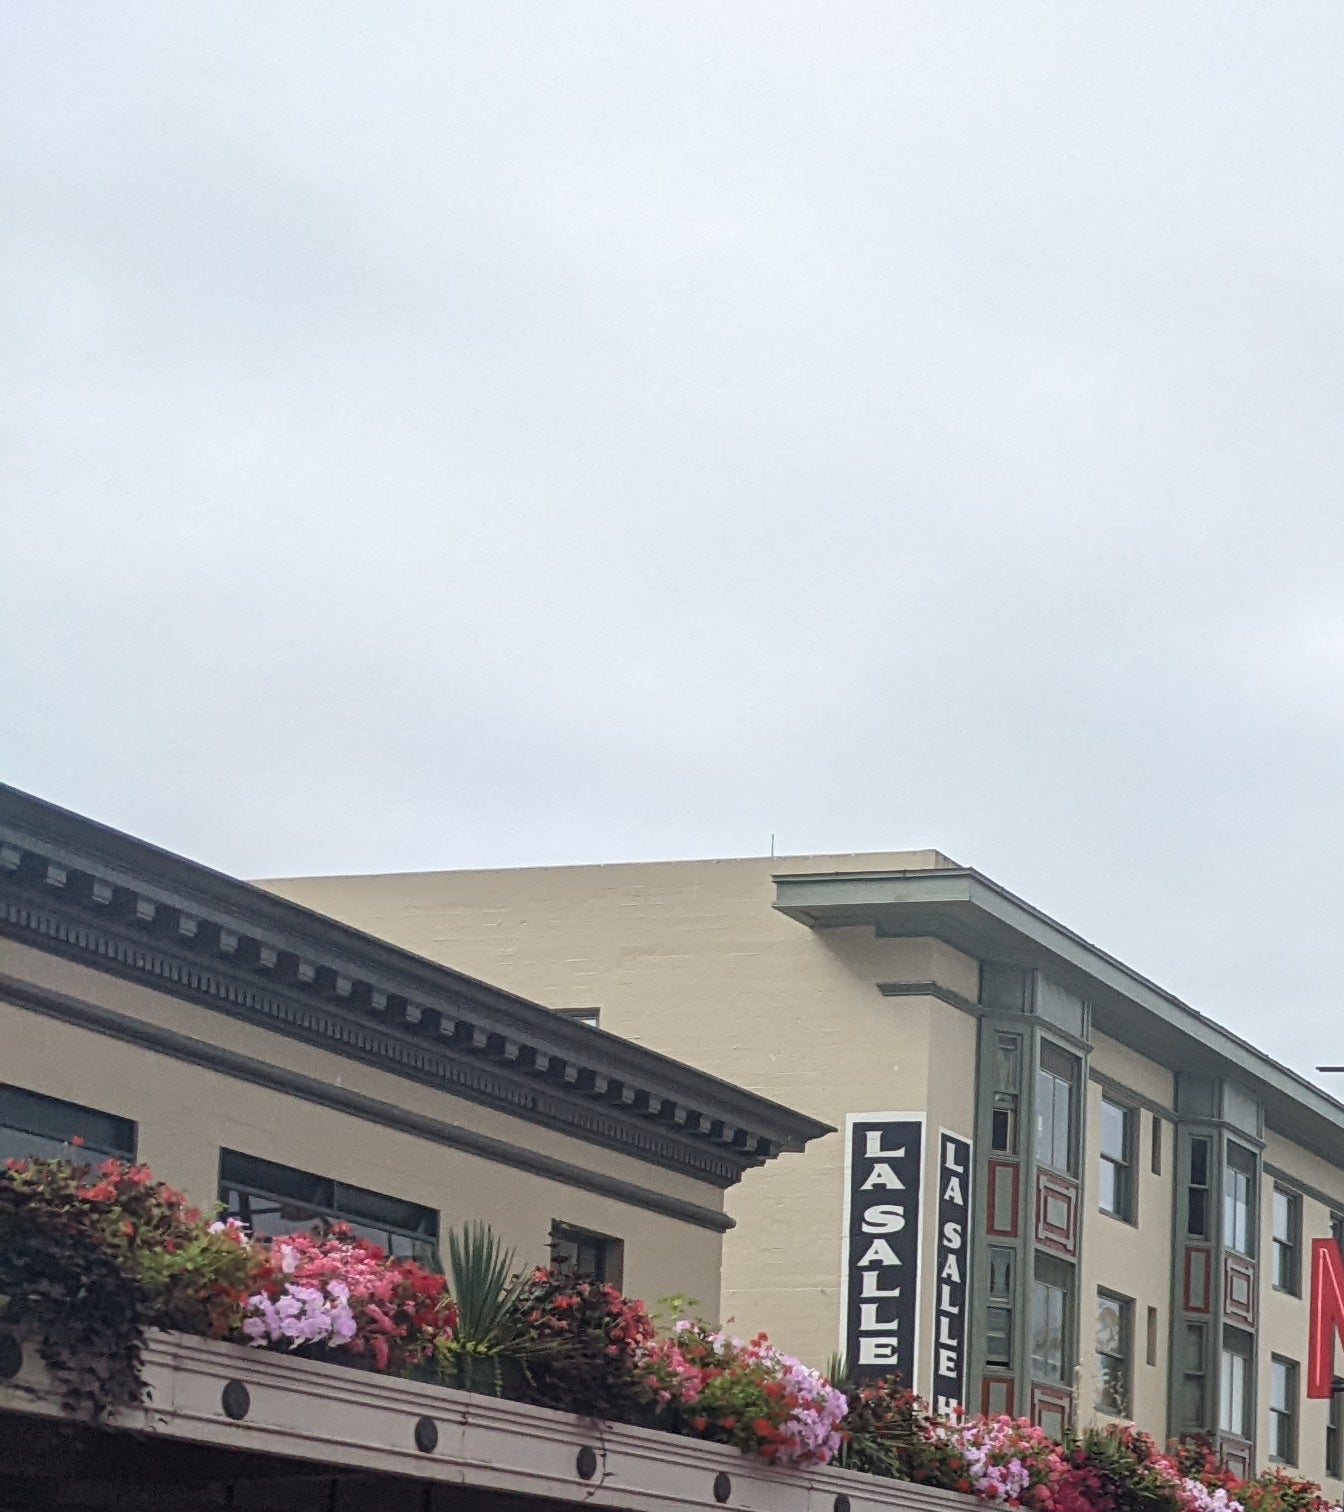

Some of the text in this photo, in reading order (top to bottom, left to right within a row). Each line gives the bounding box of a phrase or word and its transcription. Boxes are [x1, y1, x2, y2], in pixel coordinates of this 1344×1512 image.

[856, 1130, 906, 1366] LA SALLE
[943, 1141, 964, 1206] LA
[938, 1221, 963, 1379] SALLE
